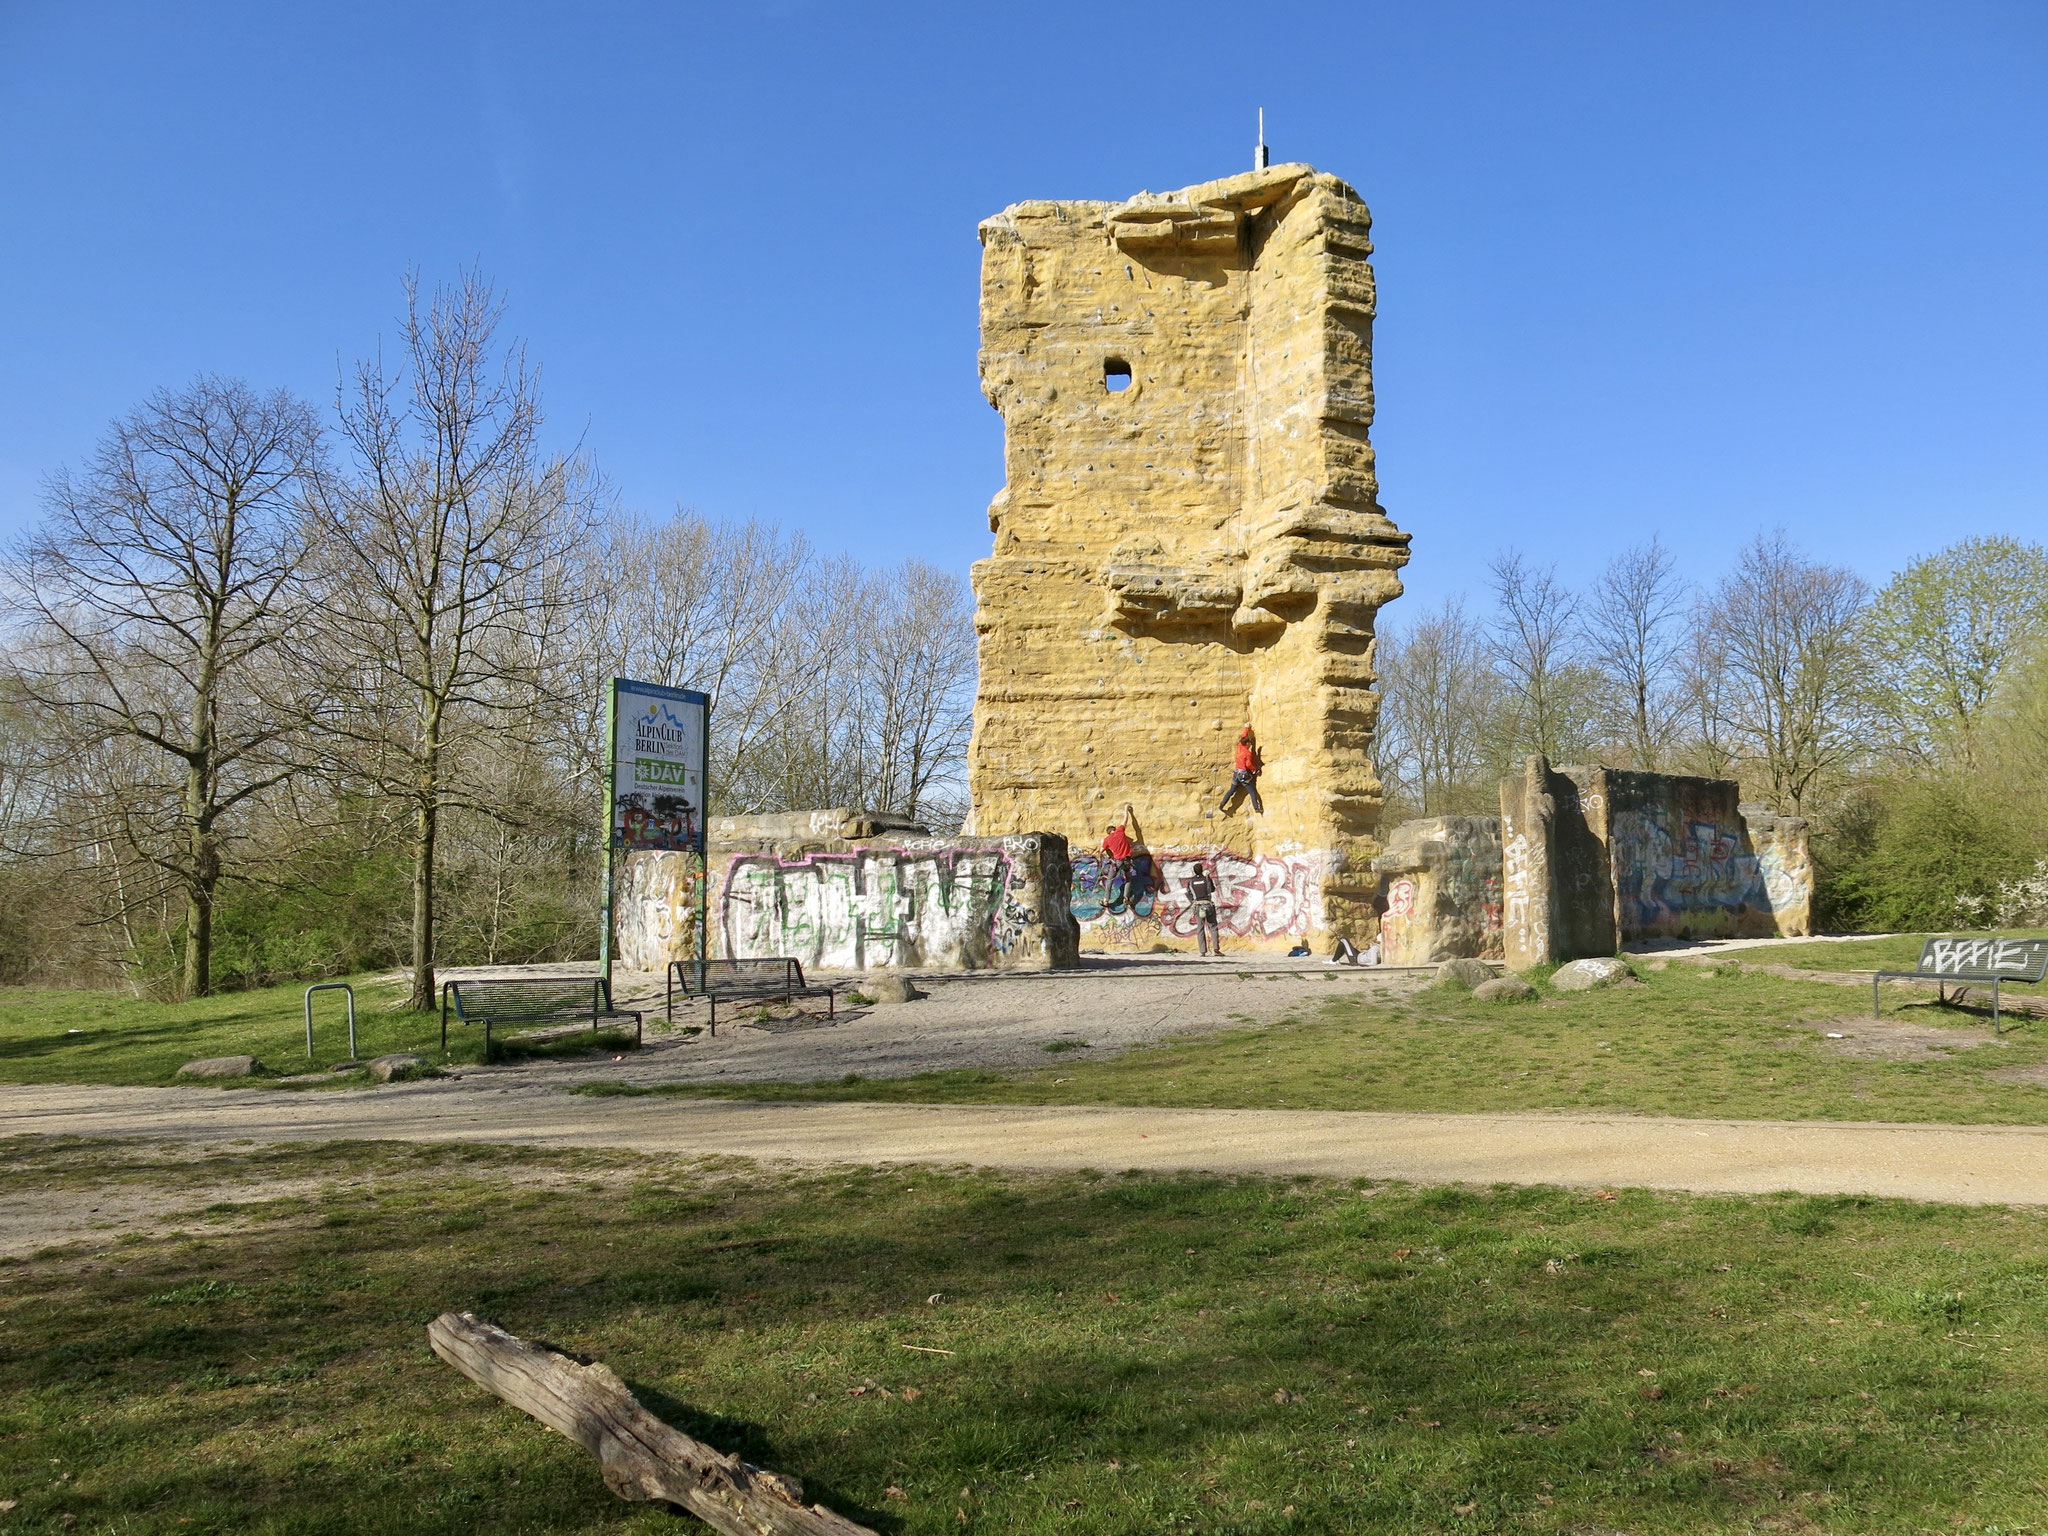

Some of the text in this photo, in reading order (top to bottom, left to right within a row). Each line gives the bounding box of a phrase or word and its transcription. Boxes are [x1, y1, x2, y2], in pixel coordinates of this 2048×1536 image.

[635, 738, 665, 754] BERLIN
[650, 762, 684, 783] DAV
[634, 783, 686, 794] Deutscher Alpenverein
